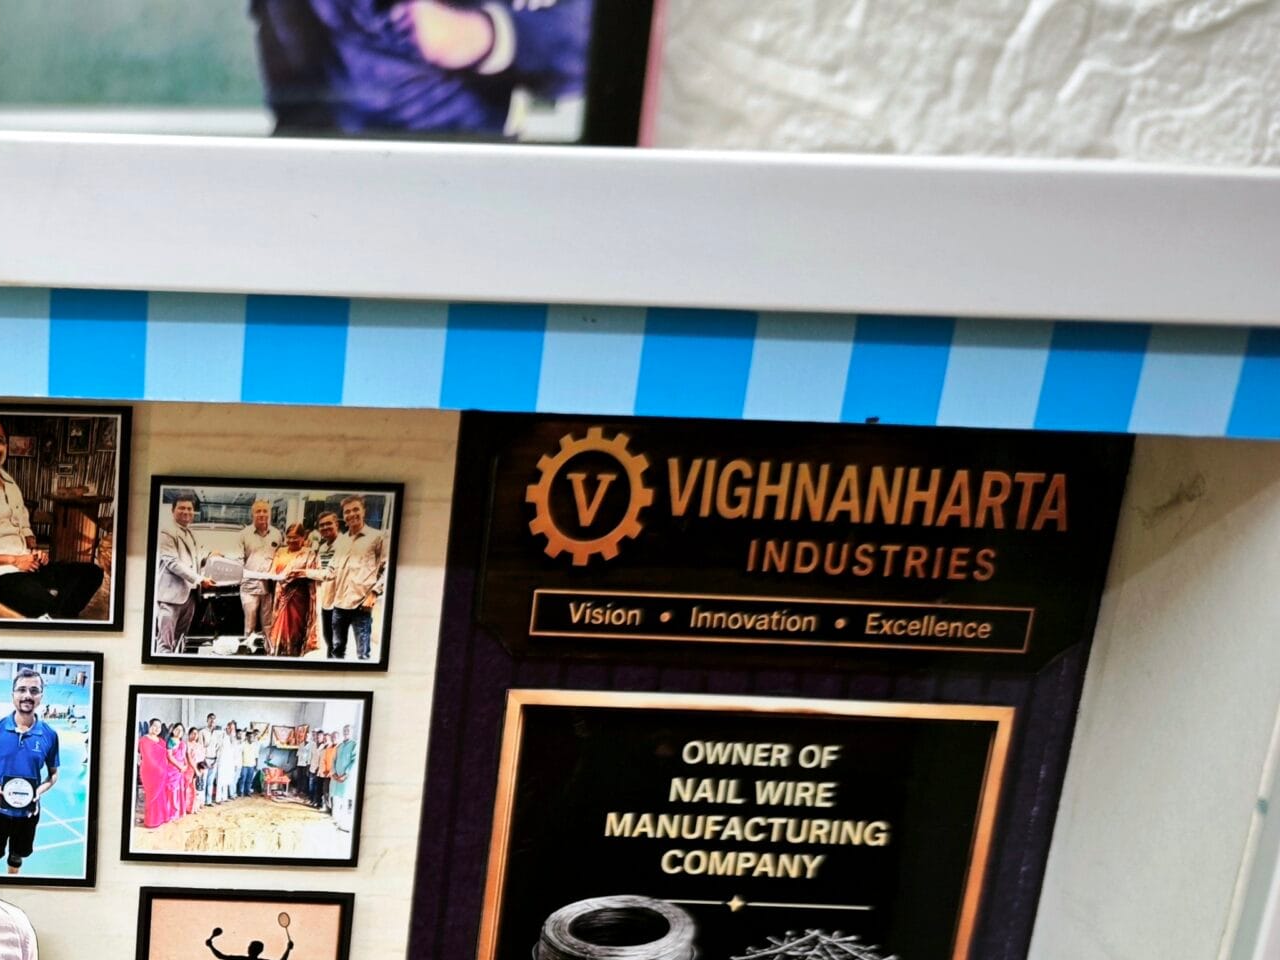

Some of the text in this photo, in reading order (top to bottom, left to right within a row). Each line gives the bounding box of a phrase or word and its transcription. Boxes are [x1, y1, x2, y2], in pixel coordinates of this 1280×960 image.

[566, 457, 1069, 532] V VIGHNANHARTA
[746, 539, 996, 581] INDUSTRIES
[568, 602, 993, 639] Vision Innovation Excellence
[681, 740, 841, 769] OWNER OF
[668, 777, 837, 808] NAIL WIRE
[604, 811, 891, 847] MANUFACTURING
[660, 849, 824, 879] COMPANY
